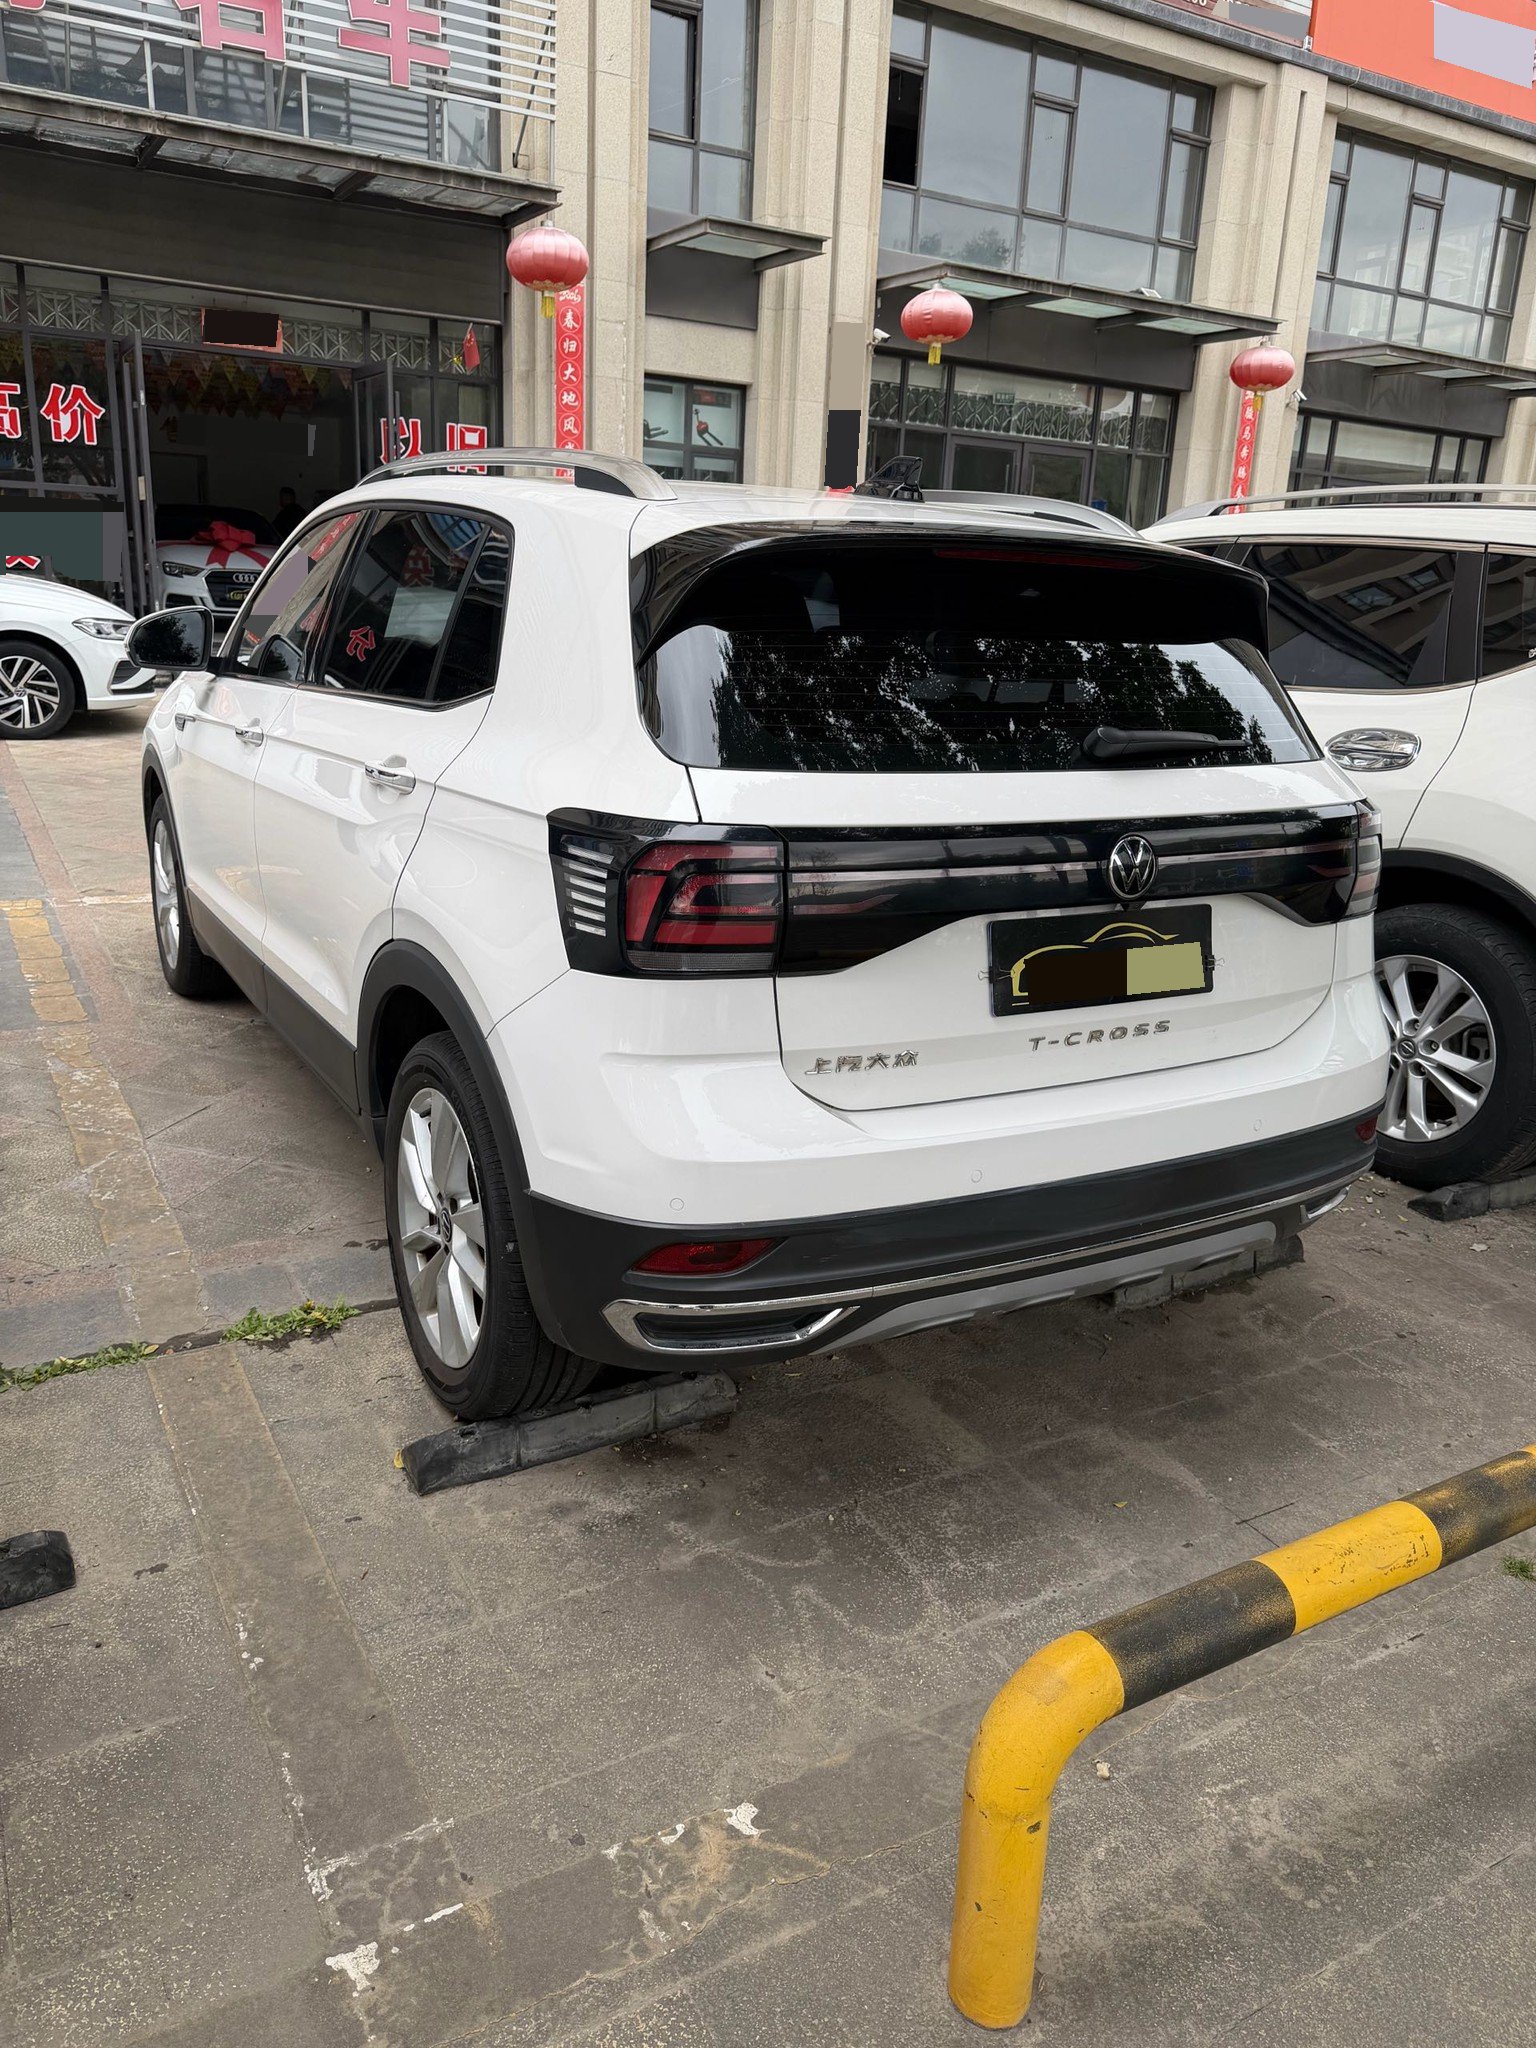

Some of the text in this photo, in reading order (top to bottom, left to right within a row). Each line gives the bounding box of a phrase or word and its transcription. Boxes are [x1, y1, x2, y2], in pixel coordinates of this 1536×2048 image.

[1028, 1019, 1171, 1052] T-CROSS
[804, 1049, 919, 1075] 上汽大众
